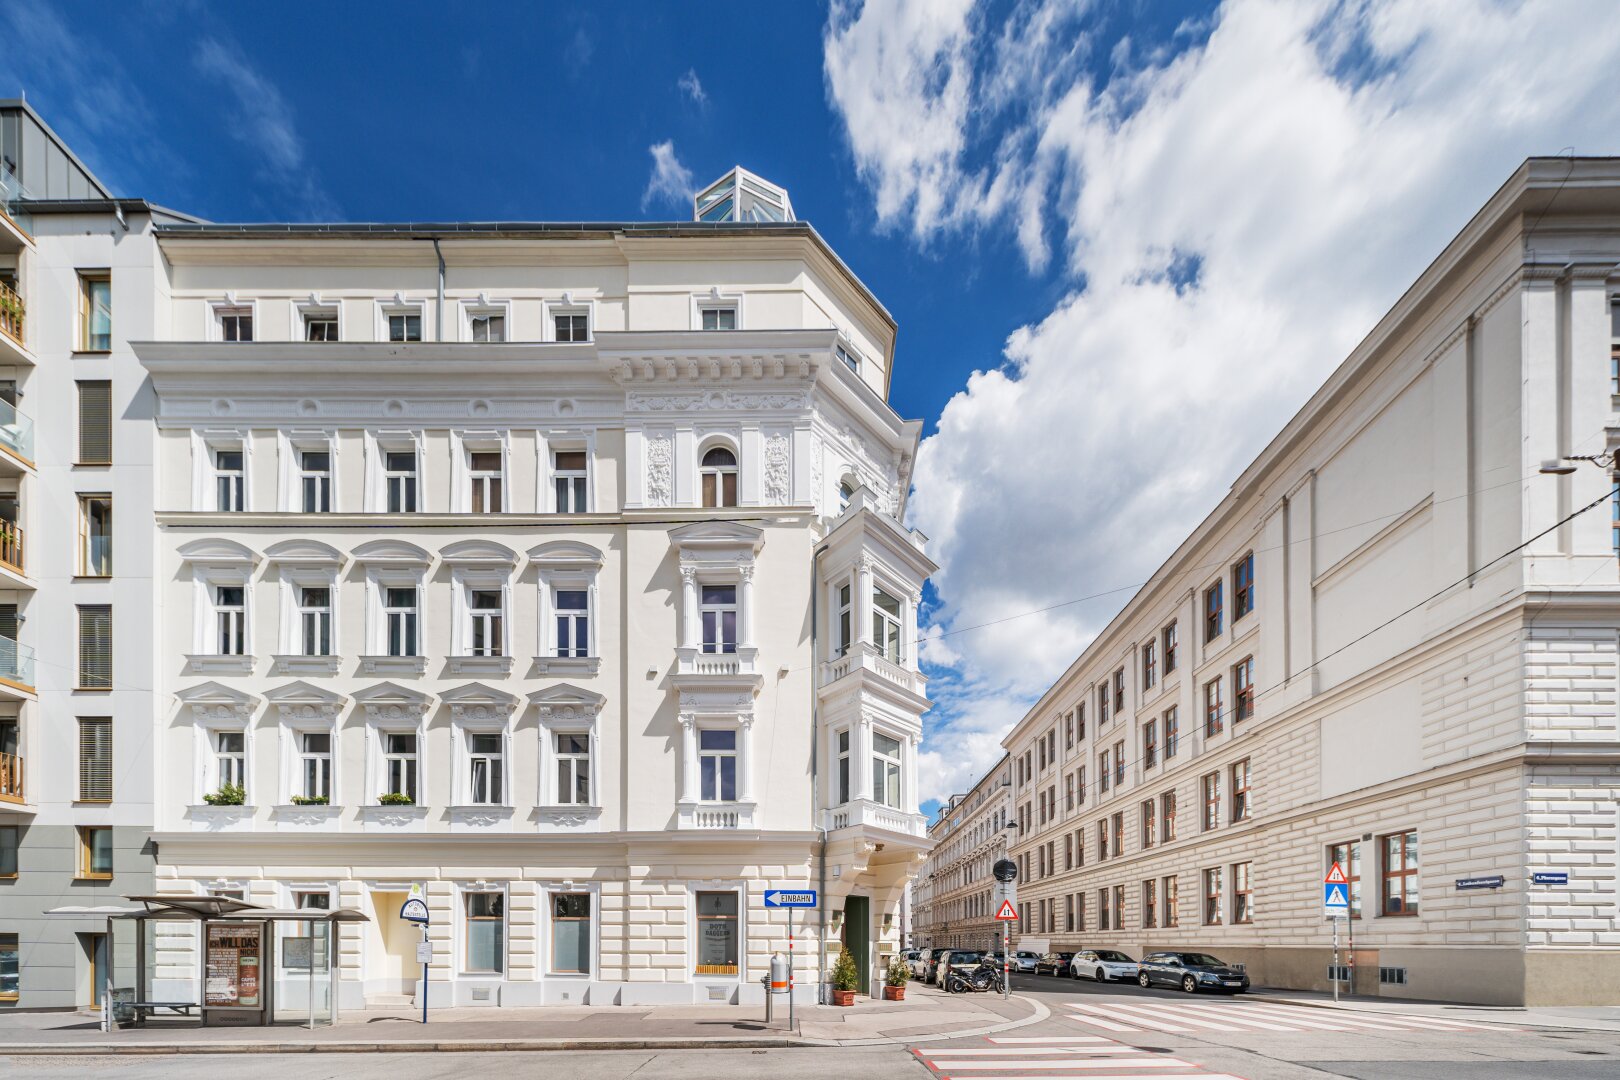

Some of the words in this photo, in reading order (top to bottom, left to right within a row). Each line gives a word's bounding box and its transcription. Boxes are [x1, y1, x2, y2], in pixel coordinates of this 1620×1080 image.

[781, 894, 811, 903] EINBAHN
[220, 937, 240, 948] WILL
[241, 937, 259, 948] DAS
[240, 948, 257, 956] NICHT
